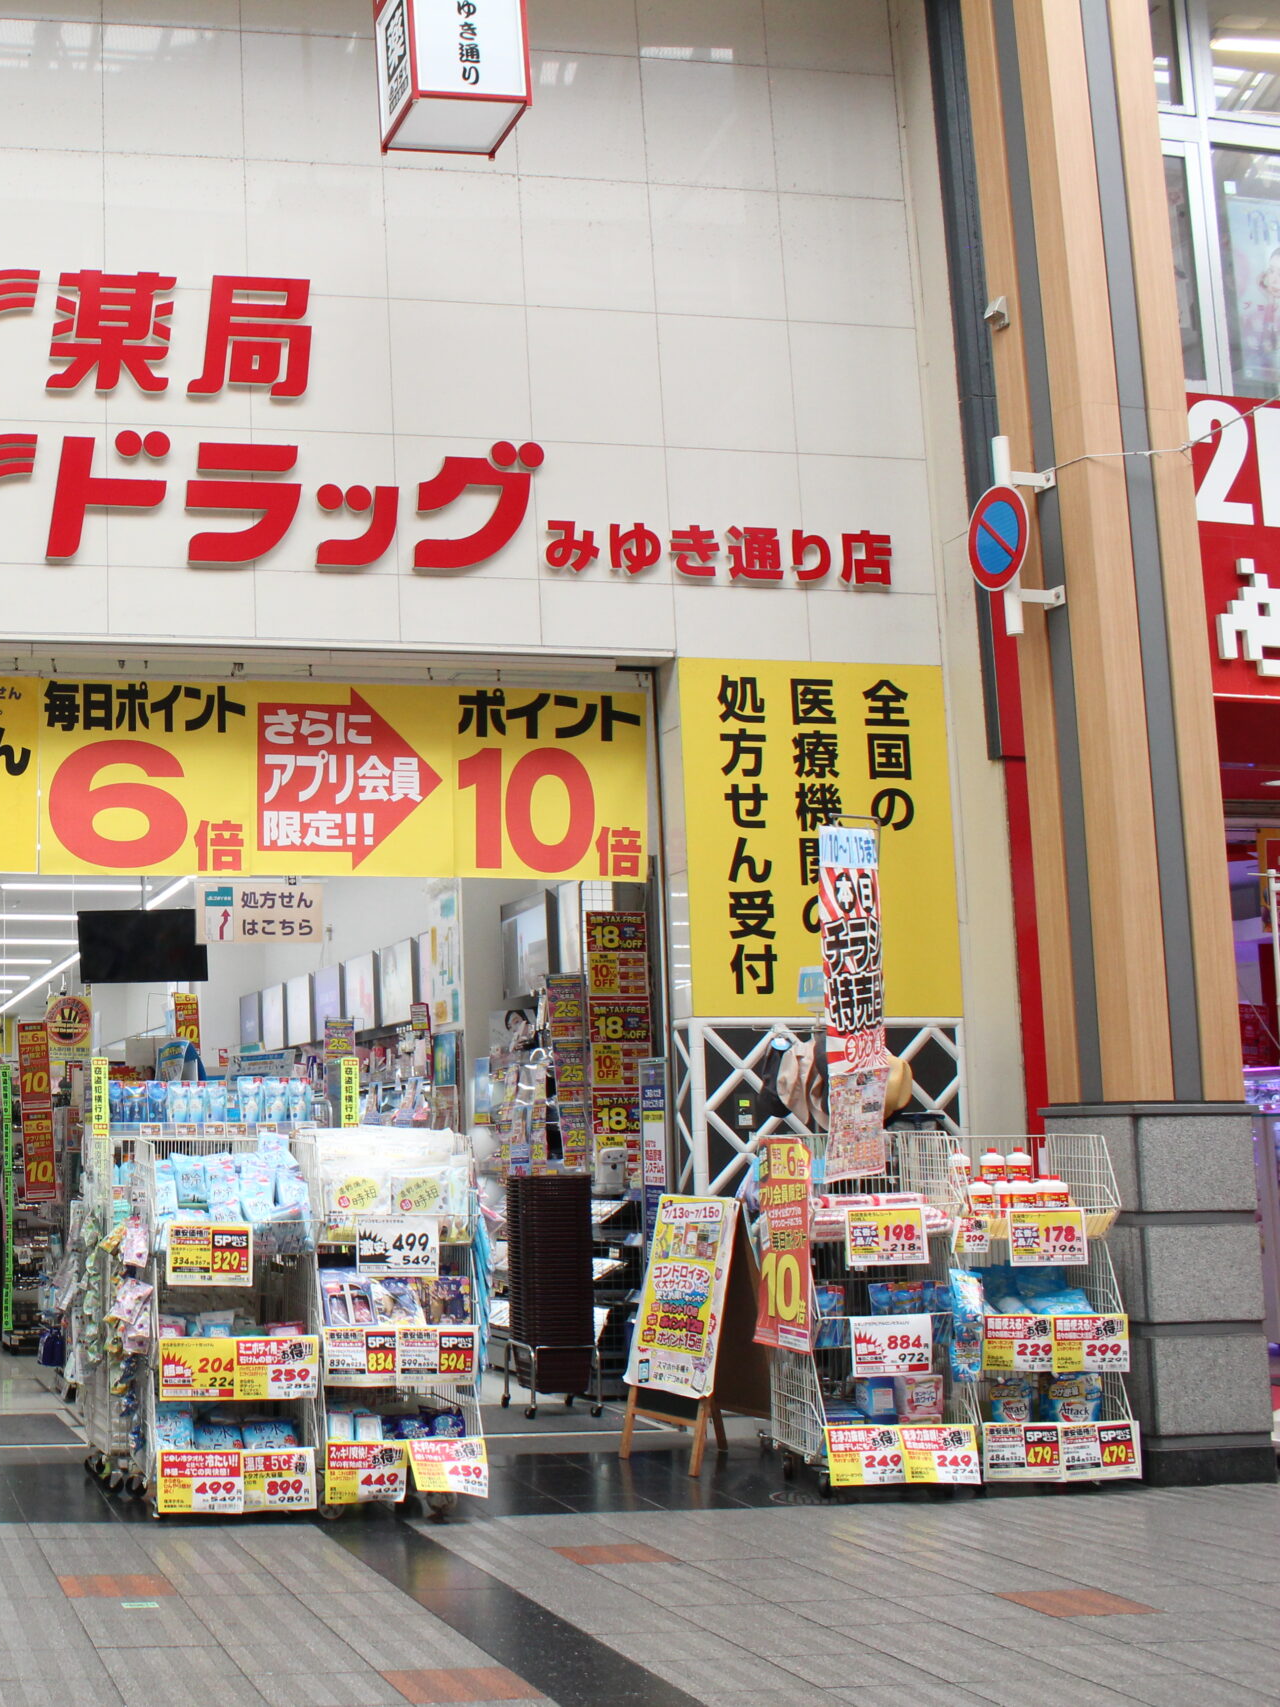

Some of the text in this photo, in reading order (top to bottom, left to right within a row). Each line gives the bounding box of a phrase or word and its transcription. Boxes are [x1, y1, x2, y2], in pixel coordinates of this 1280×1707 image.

[546, 520, 892, 587] みゆき通り店
[44, 681, 246, 733] 毎日ポイント
[264, 710, 372, 746] さらに
[458, 688, 640, 741] ポイント
[264, 750, 423, 804] アプリ会員
[862, 679, 914, 831] 全国の
[717, 675, 777, 994] 処方せん受付
[241, 891, 313, 909] 処方せん
[835, 872, 874, 912] 本日
[242, 919, 313, 936] はこちら
[654, 1265, 710, 1283] コンドロイチン
[1059, 1403, 1089, 1415] Attack
